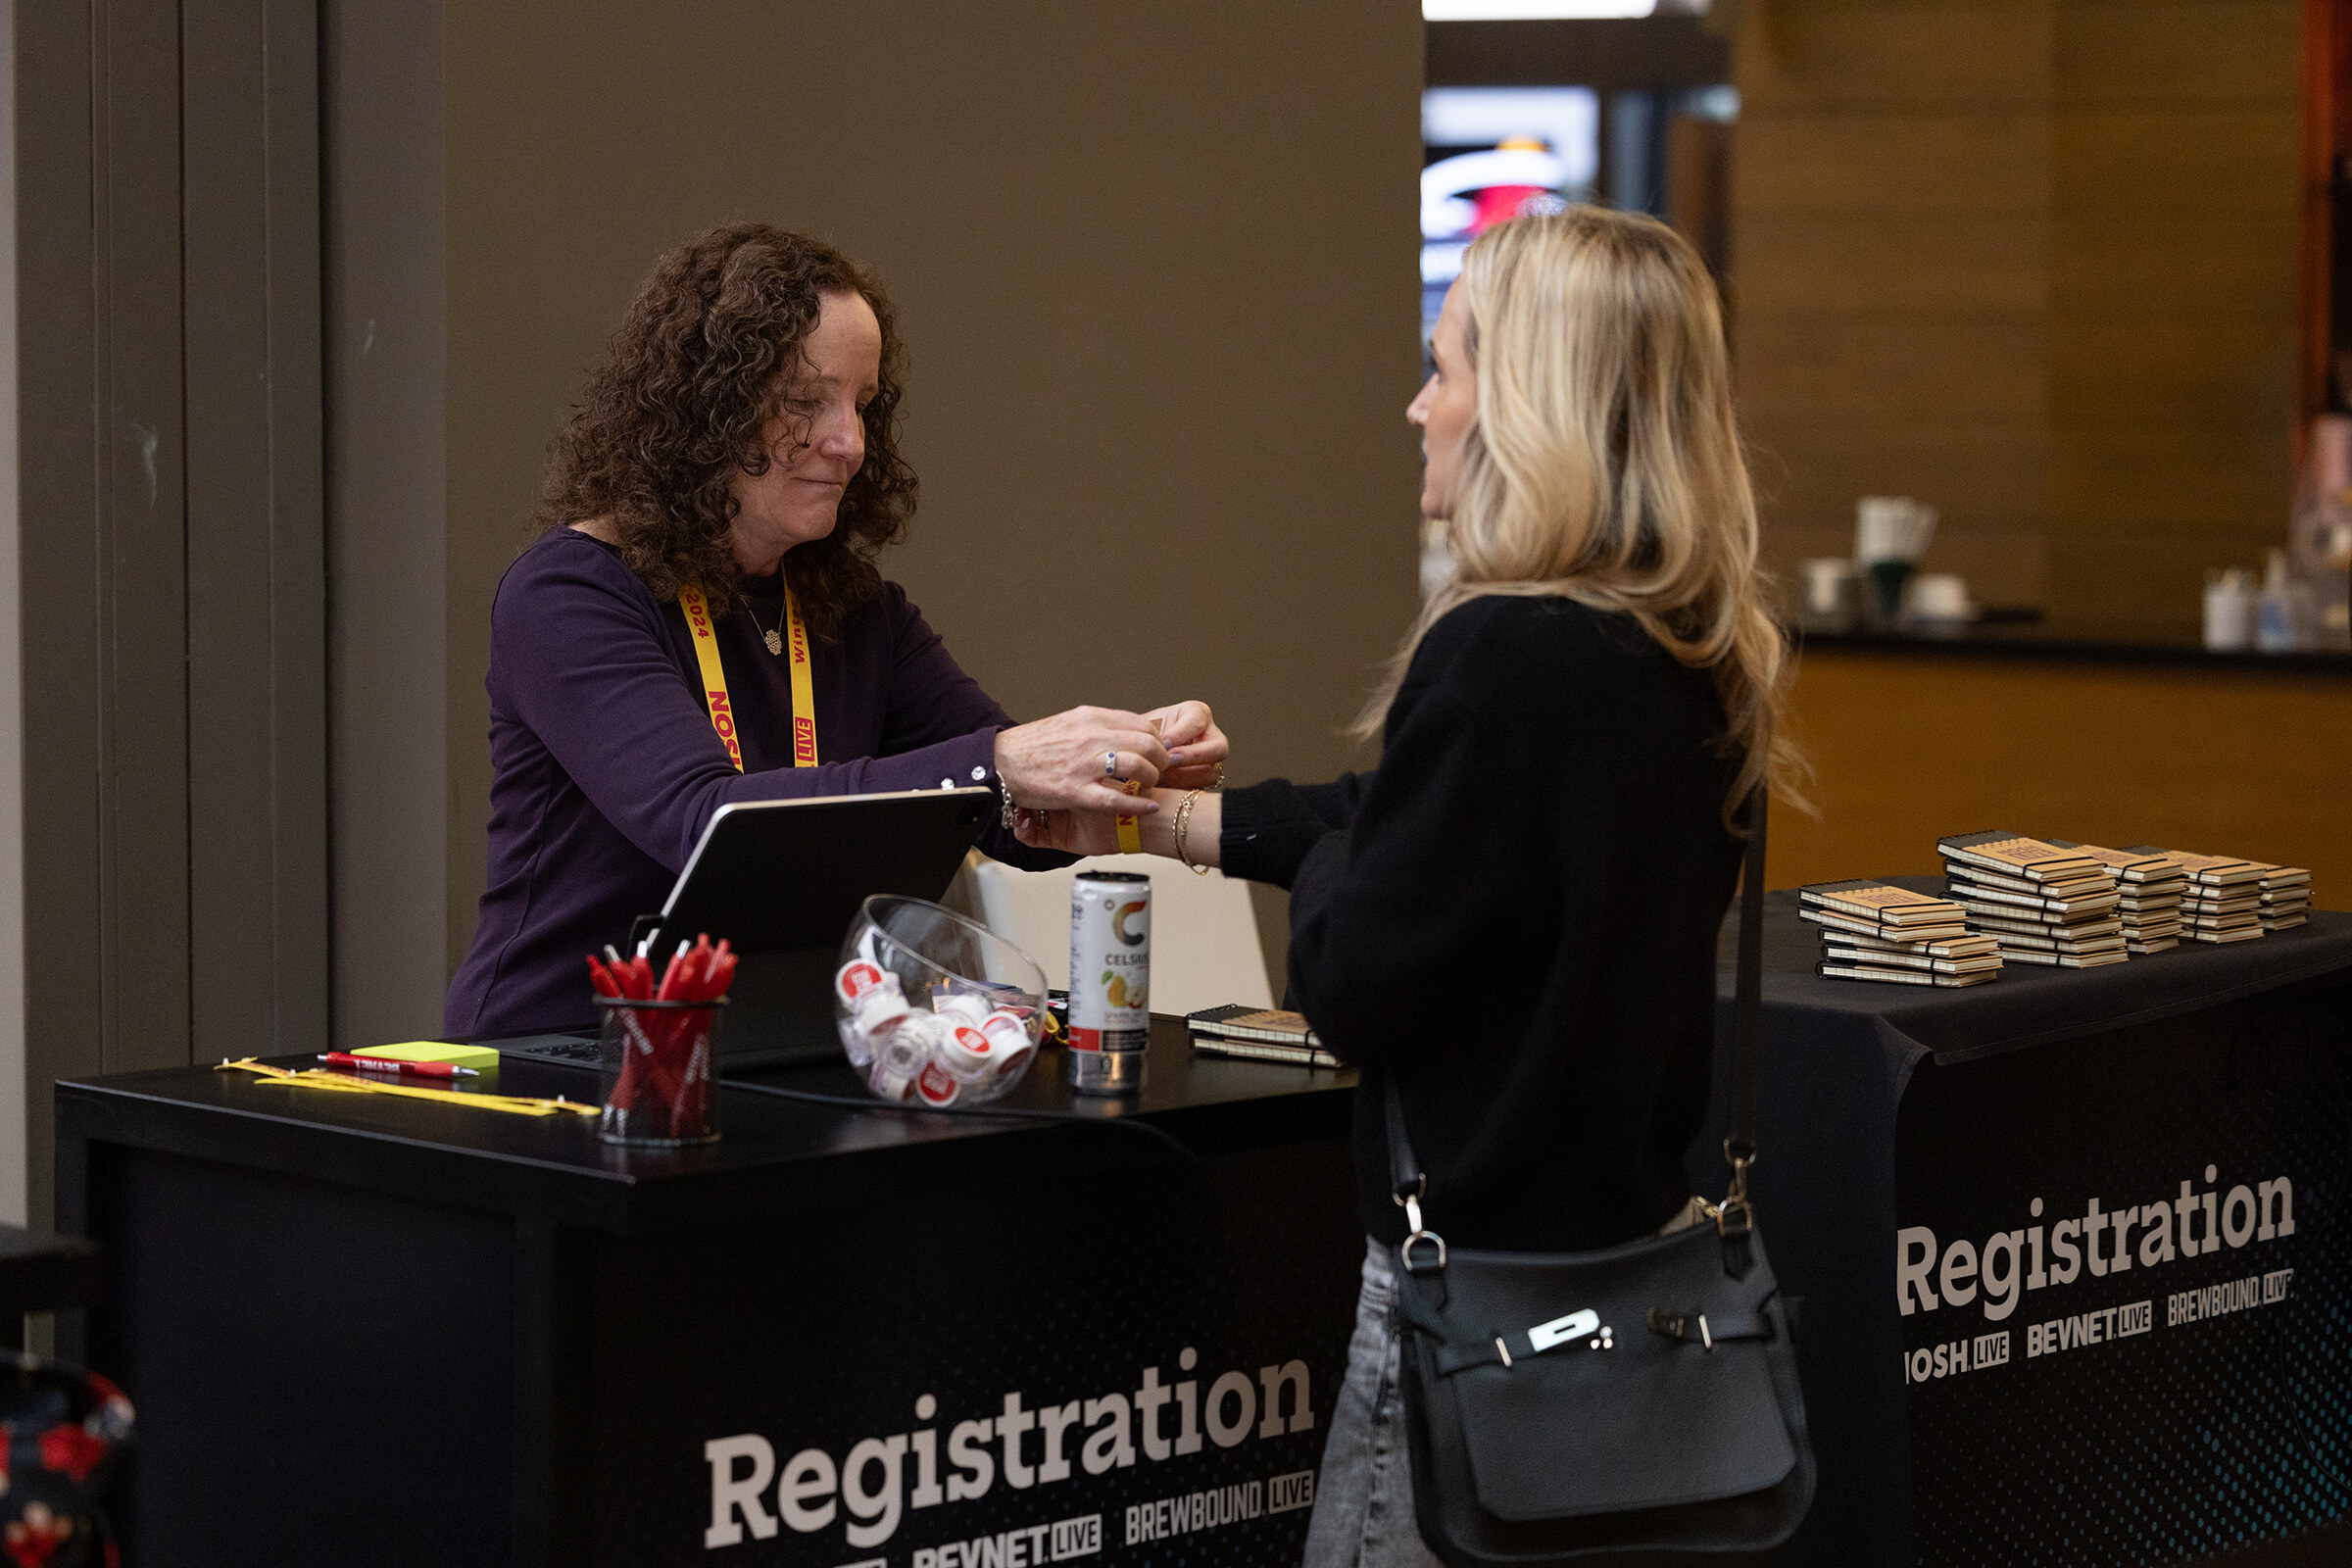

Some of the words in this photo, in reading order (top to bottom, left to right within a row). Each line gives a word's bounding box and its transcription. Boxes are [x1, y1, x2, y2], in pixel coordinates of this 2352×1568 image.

[686, 593, 710, 639] 2024
[790, 607, 807, 663] Winte
[709, 690, 741, 765] NOS
[796, 718, 813, 760] LIVE
[1896, 1163, 2296, 1322] Registration
[1904, 1339, 1969, 1386] OSH
[1976, 1334, 2008, 1366] LIVE
[2027, 1307, 2117, 1358] BEVNET
[2120, 1302, 2150, 1335] LIVE
[2167, 1276, 2259, 1328] BREWBOUND
[2263, 1272, 2292, 1301] LIV
[704, 1347, 1316, 1548] Registration
[1054, 1517, 1100, 1557] LIVE
[1125, 1480, 1262, 1546] BREWBOUND
[1271, 1473, 1312, 1510] LIVE
